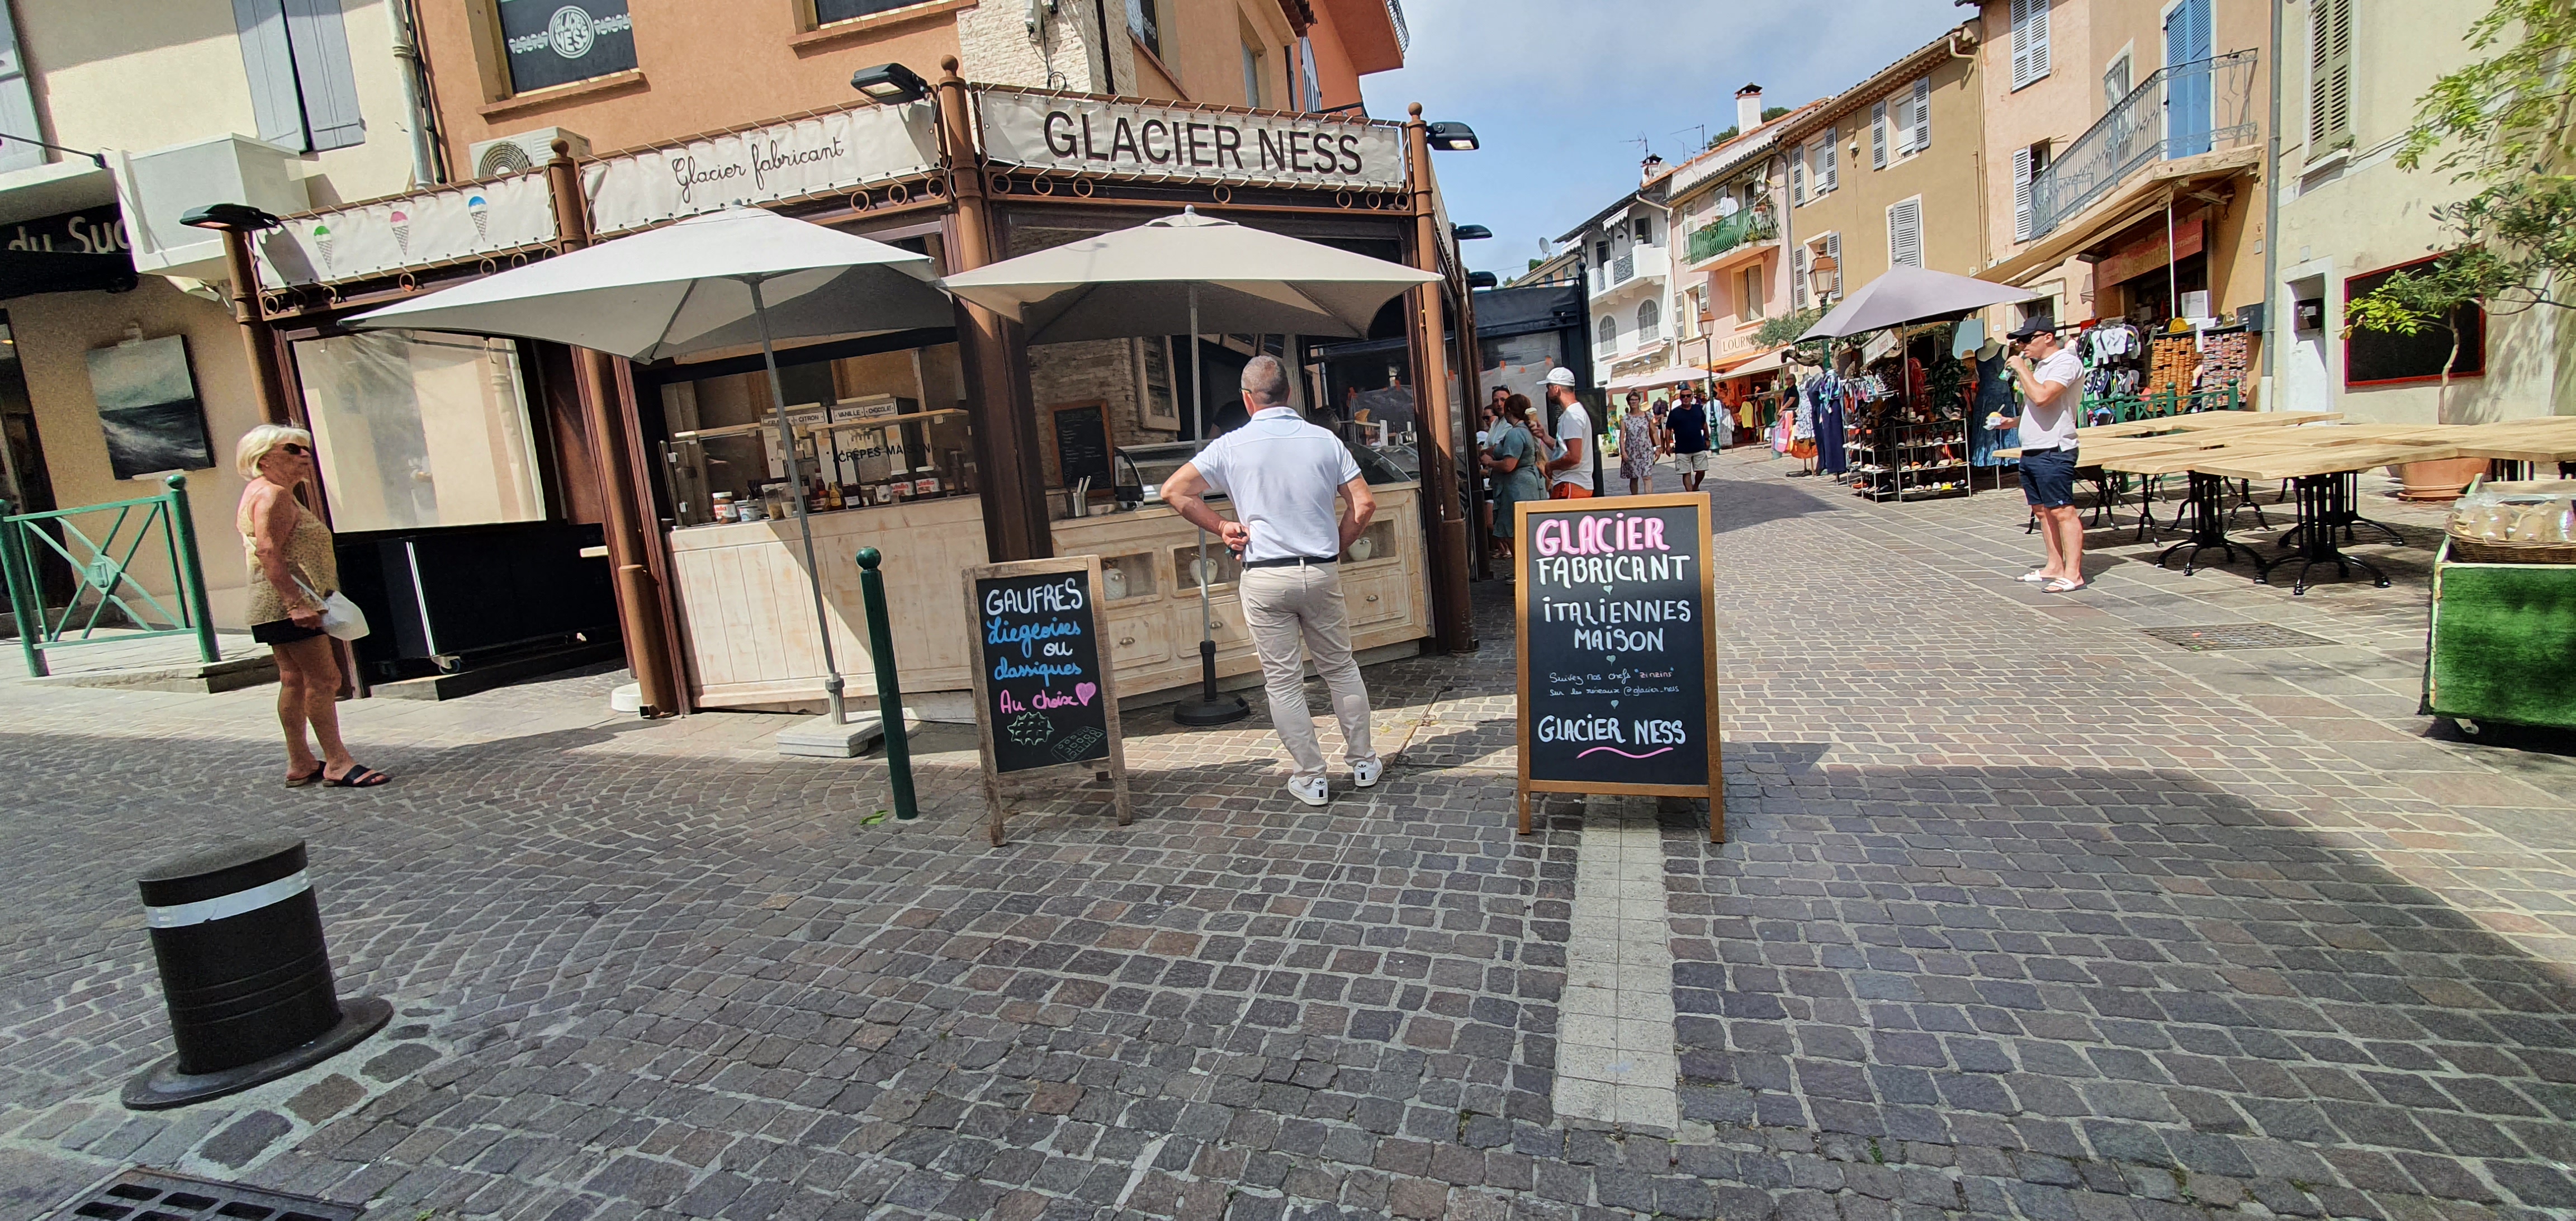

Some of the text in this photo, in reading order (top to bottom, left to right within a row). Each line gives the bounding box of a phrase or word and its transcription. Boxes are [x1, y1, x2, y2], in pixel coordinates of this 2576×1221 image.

[556, 26, 588, 51] NESS
[1044, 110, 1362, 175] GLACIER NESS
[671, 136, 845, 204] Glacier fabricant
[838, 447, 881, 462] CRÊPES
[986, 578, 1083, 616] GAUFRES
[1044, 641, 1073, 657] ou
[1000, 689, 1078, 714] Au choix
[1635, 720, 1686, 745] NESS
